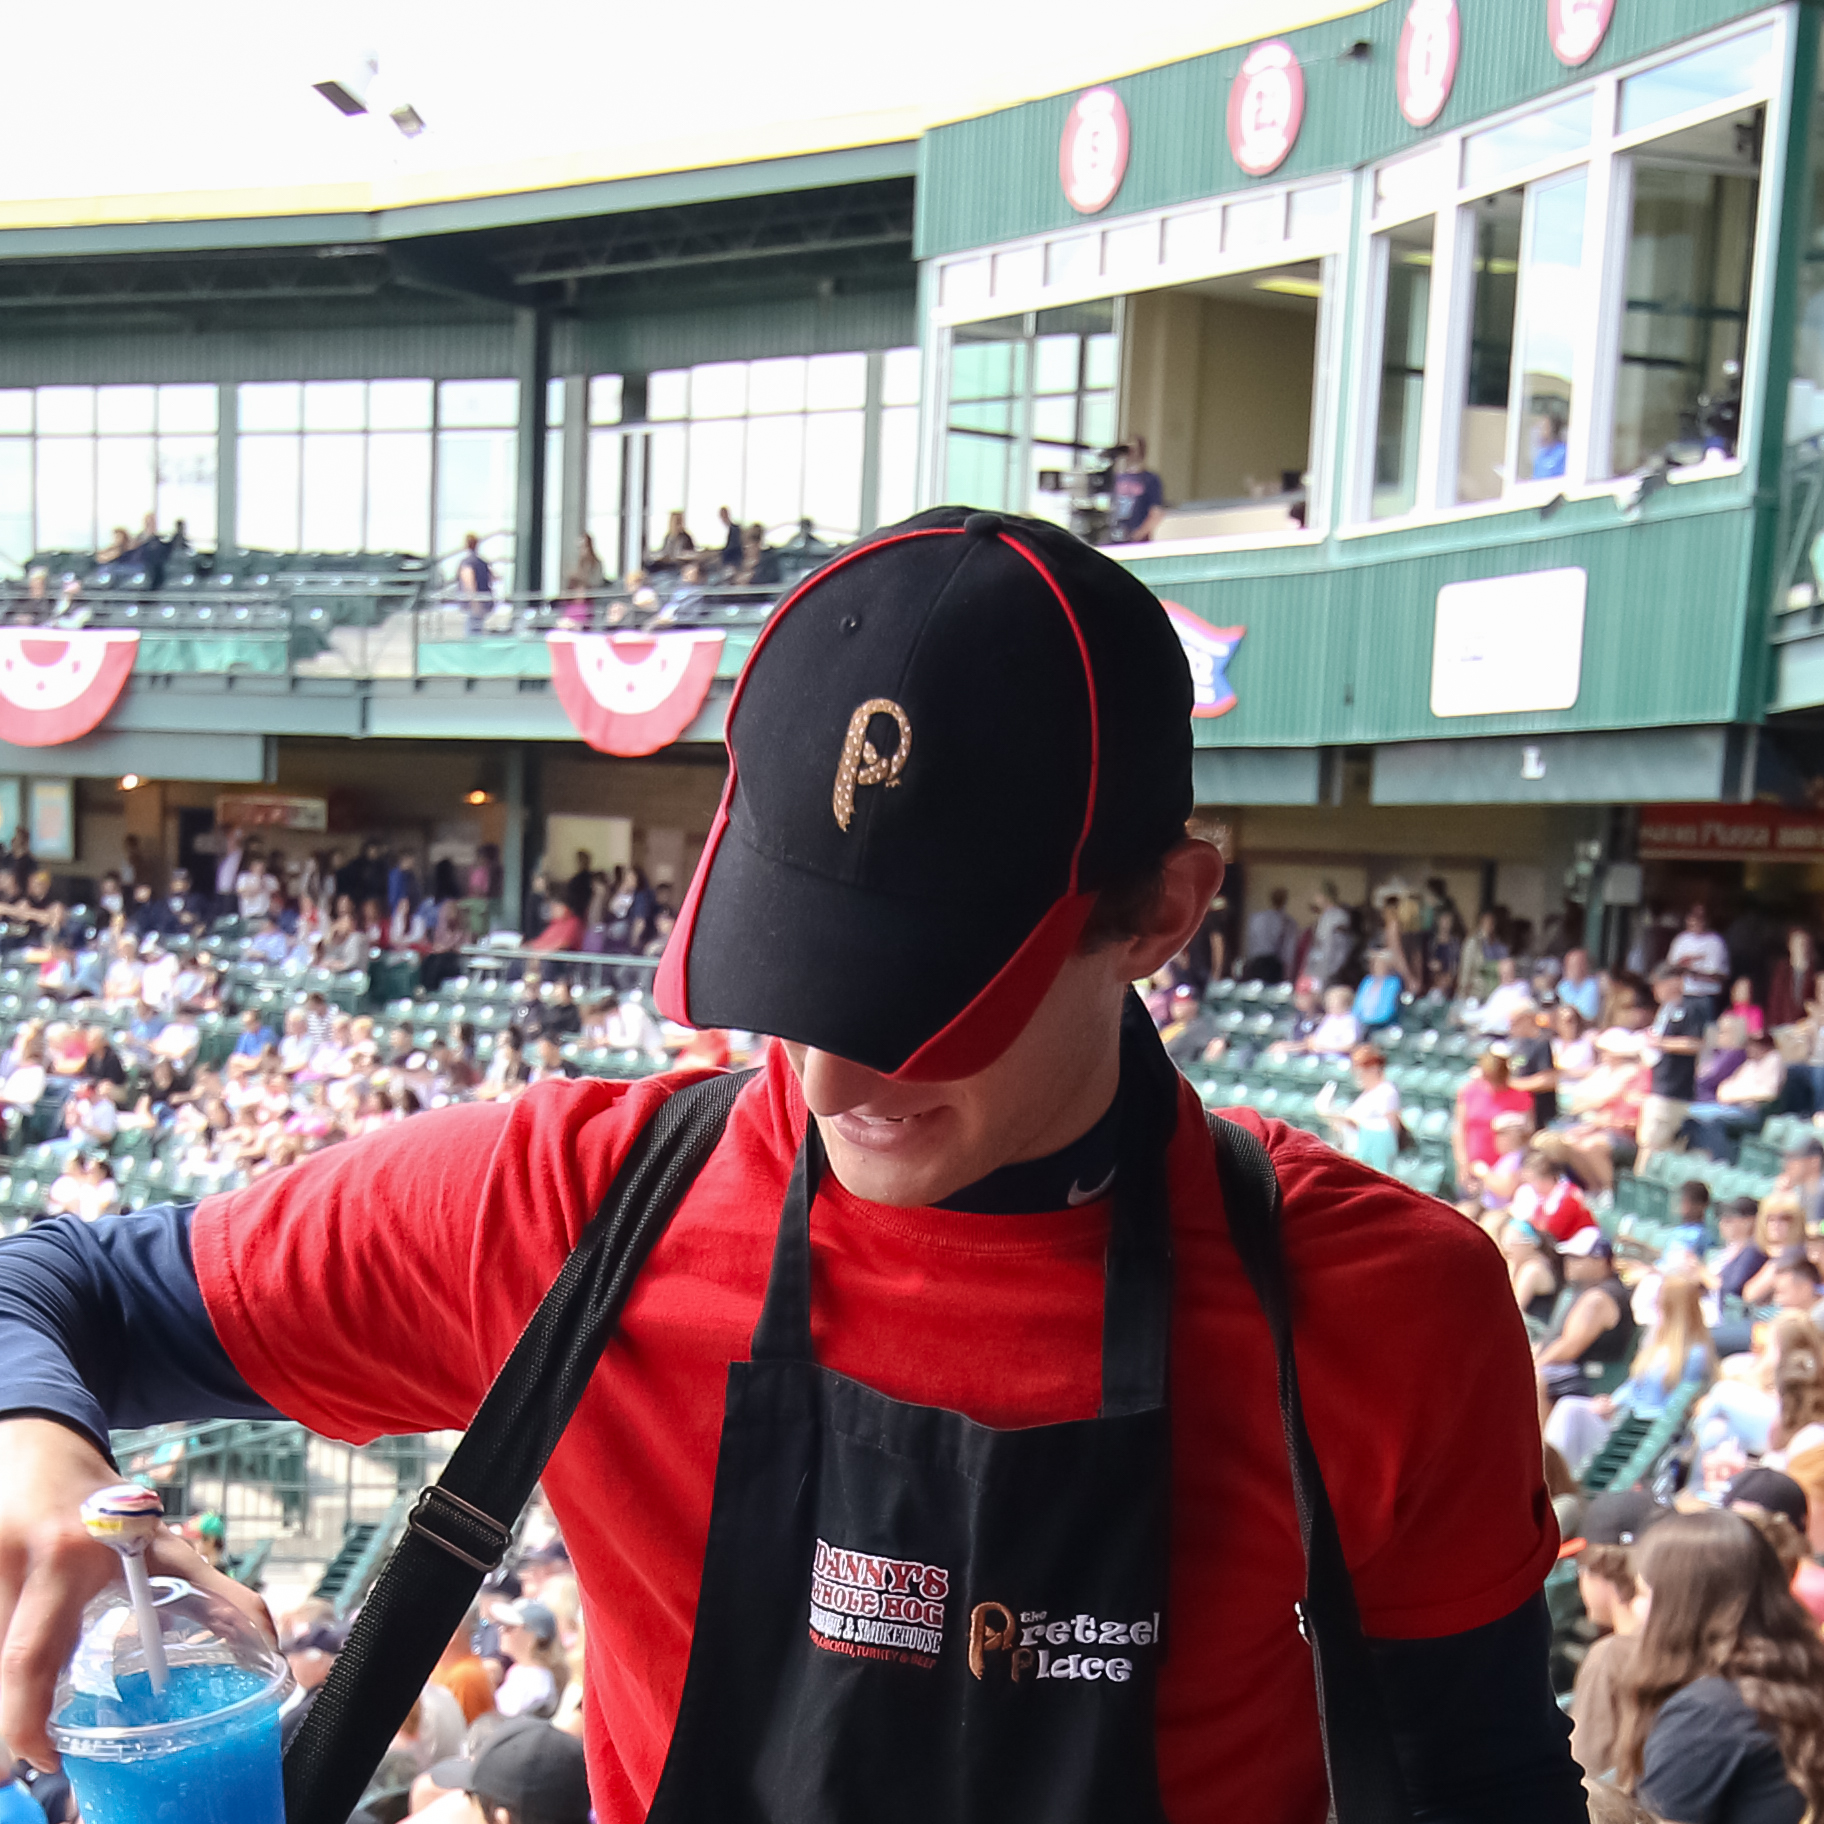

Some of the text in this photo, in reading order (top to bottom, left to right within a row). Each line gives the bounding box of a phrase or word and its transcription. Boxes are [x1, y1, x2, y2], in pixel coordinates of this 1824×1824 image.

[812, 1538, 949, 1600] DANNY'S
[810, 1572, 945, 1629] WHOLE HOG
[1019, 1610, 1048, 1624] the
[842, 1616, 855, 1640] &
[854, 1618, 943, 1654] SMOKEHOUSE
[1011, 1648, 1133, 1684] Place
